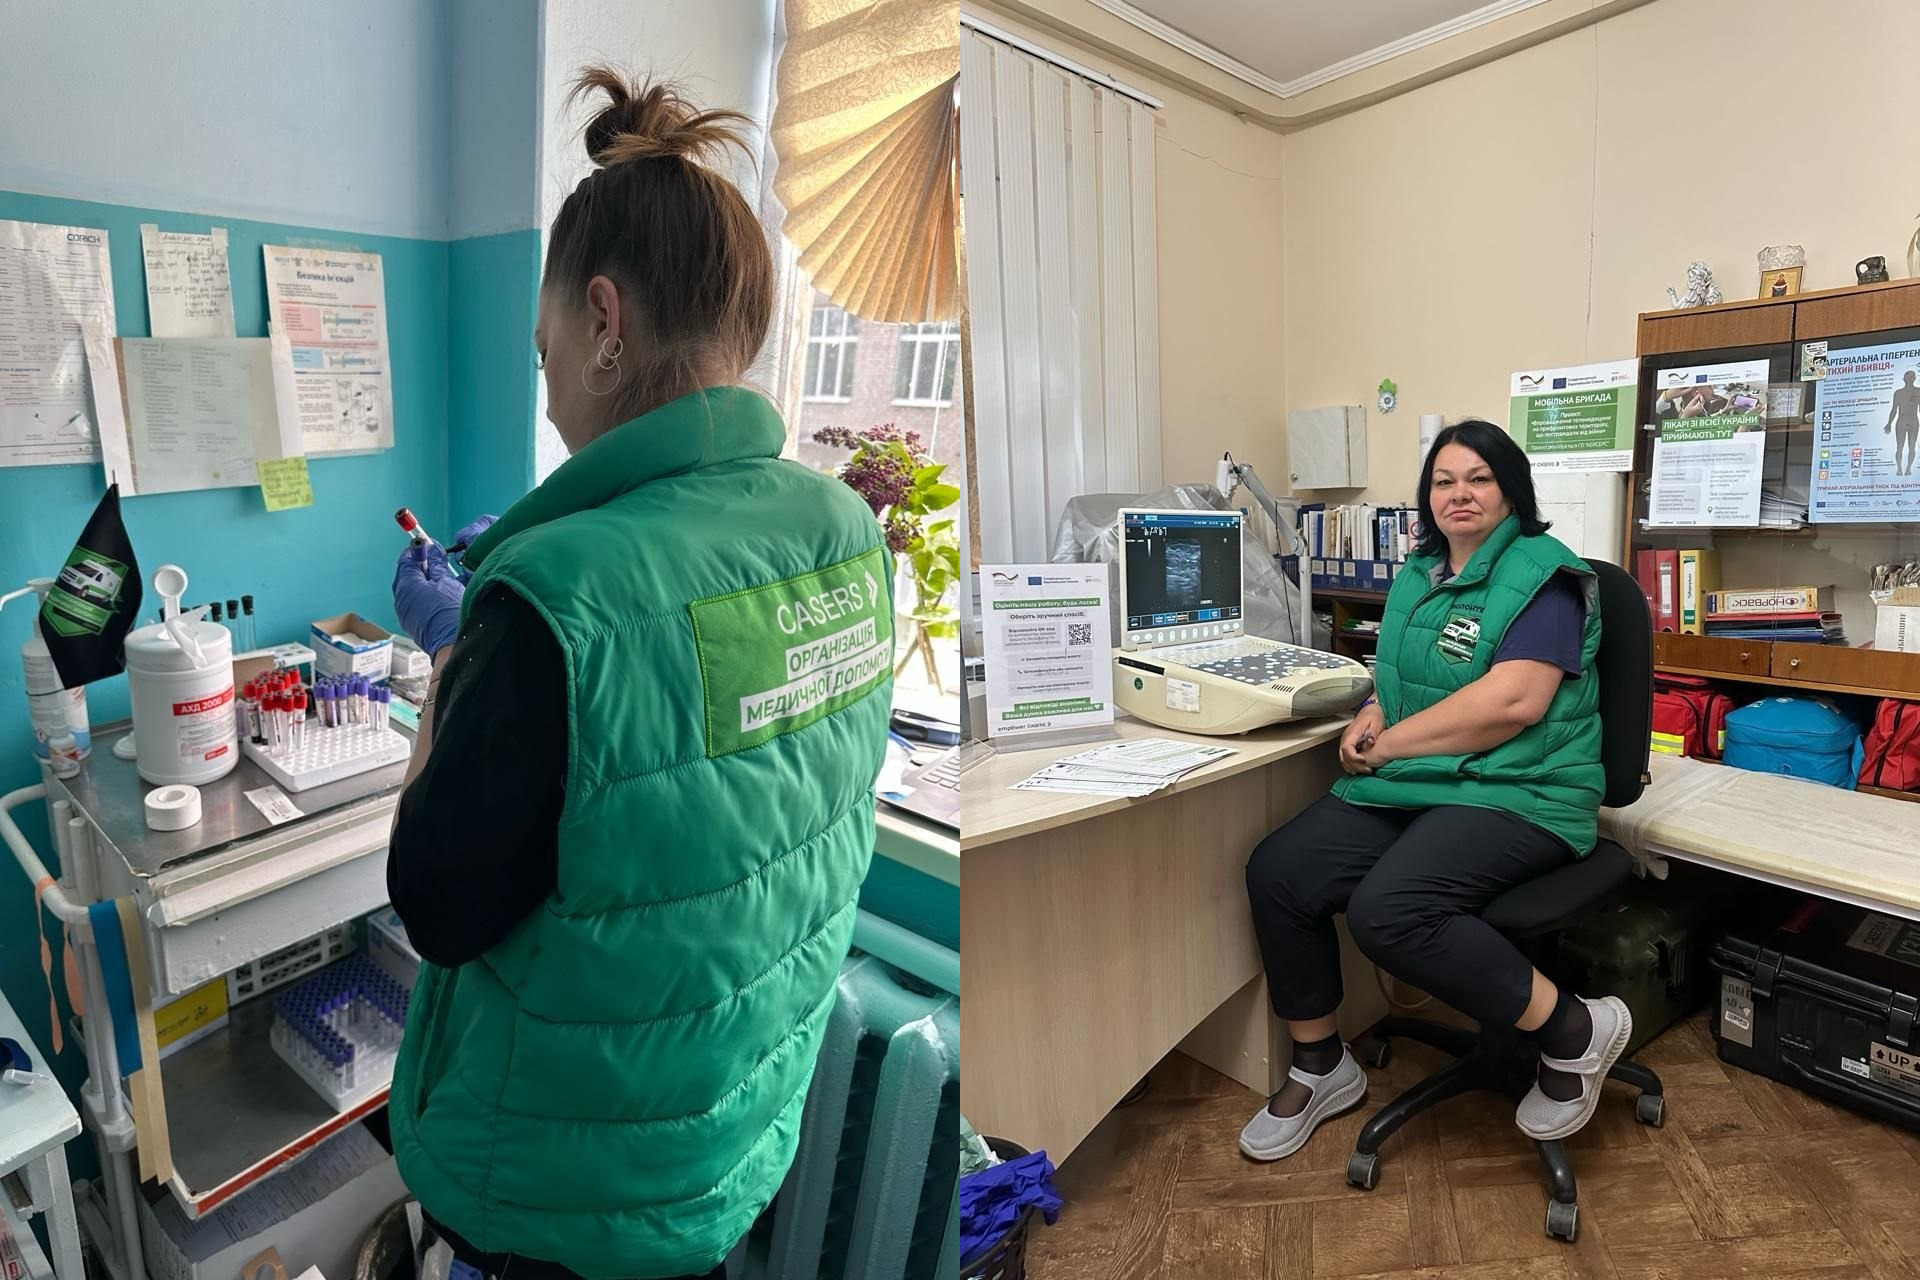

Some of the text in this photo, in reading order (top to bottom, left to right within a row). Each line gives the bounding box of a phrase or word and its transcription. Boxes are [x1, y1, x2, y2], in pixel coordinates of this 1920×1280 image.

[1534, 392, 1612, 407] МОБІЛЬНА БРИГАДА
[1663, 415, 1759, 429] ЛІКАРІ ЗІ ВСІЄЇ УКРАЇНИ
[1663, 430, 1732, 441] ПРИЙМАЮТЬ ТУТ
[776, 582, 865, 635] CASERS
[1010, 613, 1036, 621] Оберіть
[1036, 612, 1063, 620] зручний
[789, 623, 874, 673] ОРГАНІЗАЦІЯ
[181, 697, 223, 713] АХД 2000
[746, 670, 832, 725] МЕДИЧНОЇ
[1023, 711, 1044, 719] думка
[1889, 1051, 1910, 1067] UP
